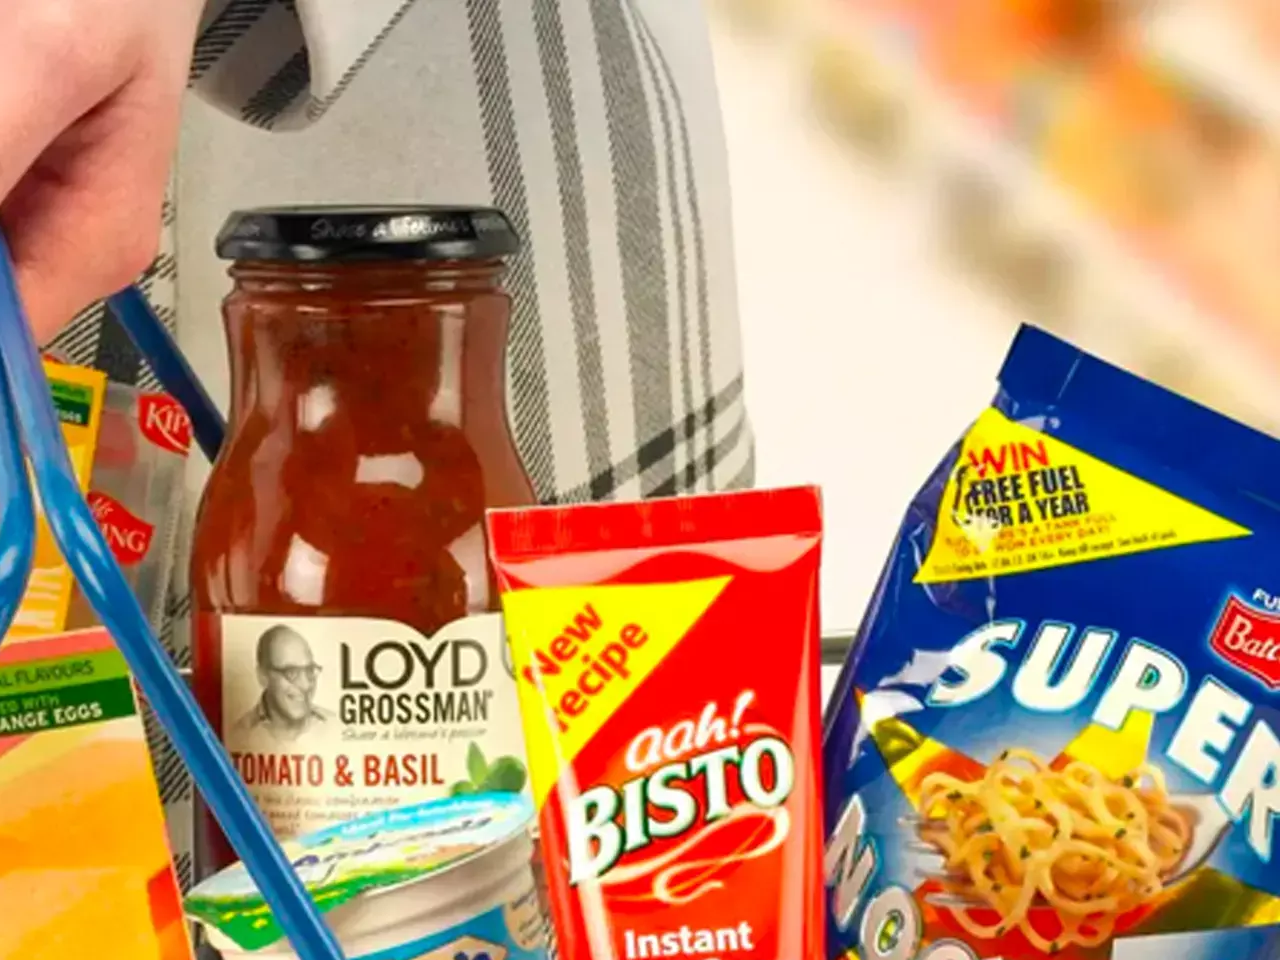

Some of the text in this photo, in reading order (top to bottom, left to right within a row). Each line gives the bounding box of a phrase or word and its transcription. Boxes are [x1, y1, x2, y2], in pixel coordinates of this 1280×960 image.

[968, 440, 1050, 479] WIN
[970, 465, 1085, 507] FREE FUEL
[975, 491, 1091, 529] FOR A YEAR
[341, 639, 488, 691] LOYD
[523, 602, 604, 690] New
[14, 660, 96, 687] FLAVOURS
[550, 621, 649, 735] recipe
[54, 702, 104, 723] EGGS
[339, 691, 490, 725] GROSSMAN
[625, 689, 755, 772] aah!
[232, 752, 445, 787] TOMATO & BASIL
[568, 736, 796, 886] BISTO
[625, 921, 754, 960] Instant
